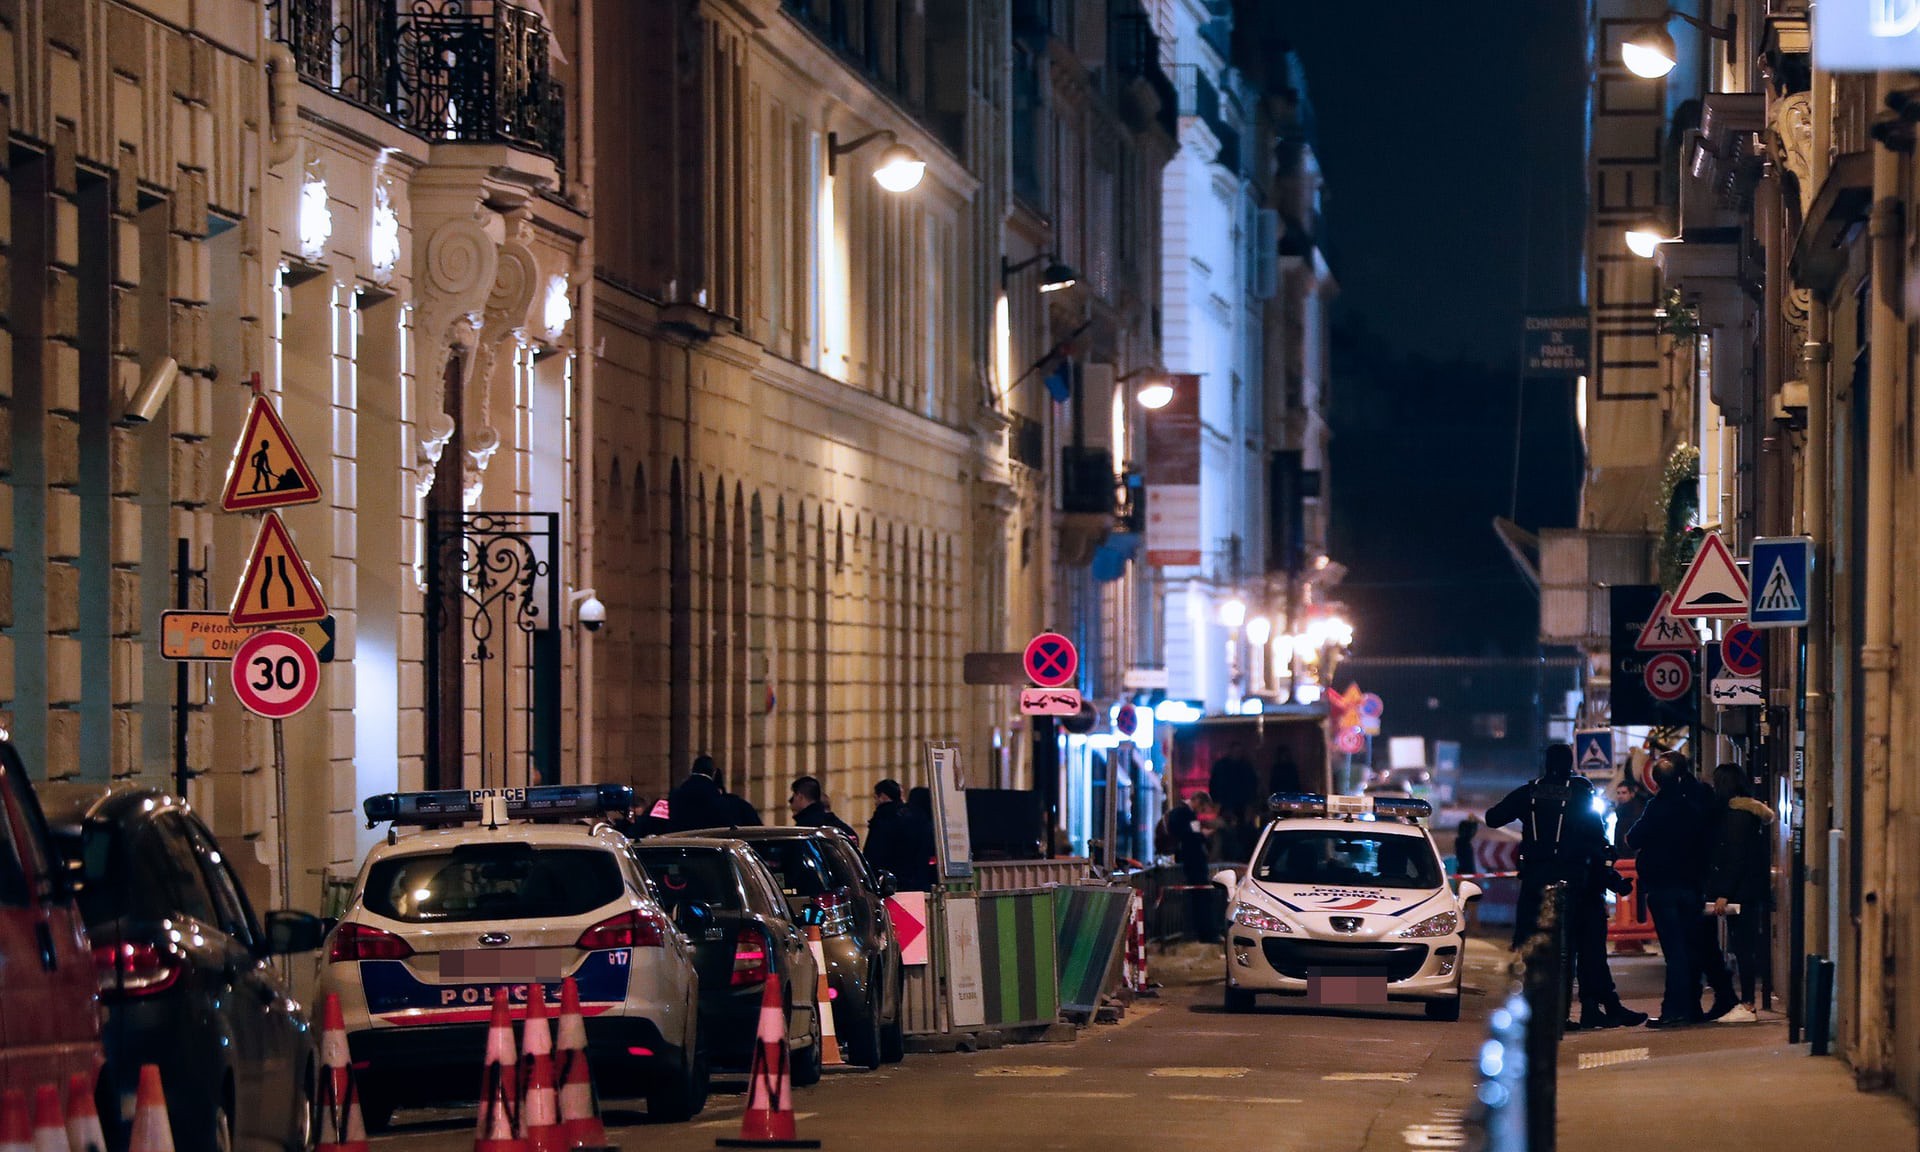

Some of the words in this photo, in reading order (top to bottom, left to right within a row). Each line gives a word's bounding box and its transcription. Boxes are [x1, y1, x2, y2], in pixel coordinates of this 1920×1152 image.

[1552, 331, 1563, 343] DE
[1541, 344, 1574, 356] FRANCE
[191, 622, 239, 634] Piétons
[252, 656, 299, 691] 30
[1656, 669, 1681, 685] 30
[1294, 892, 1401, 902] NATIONALE
